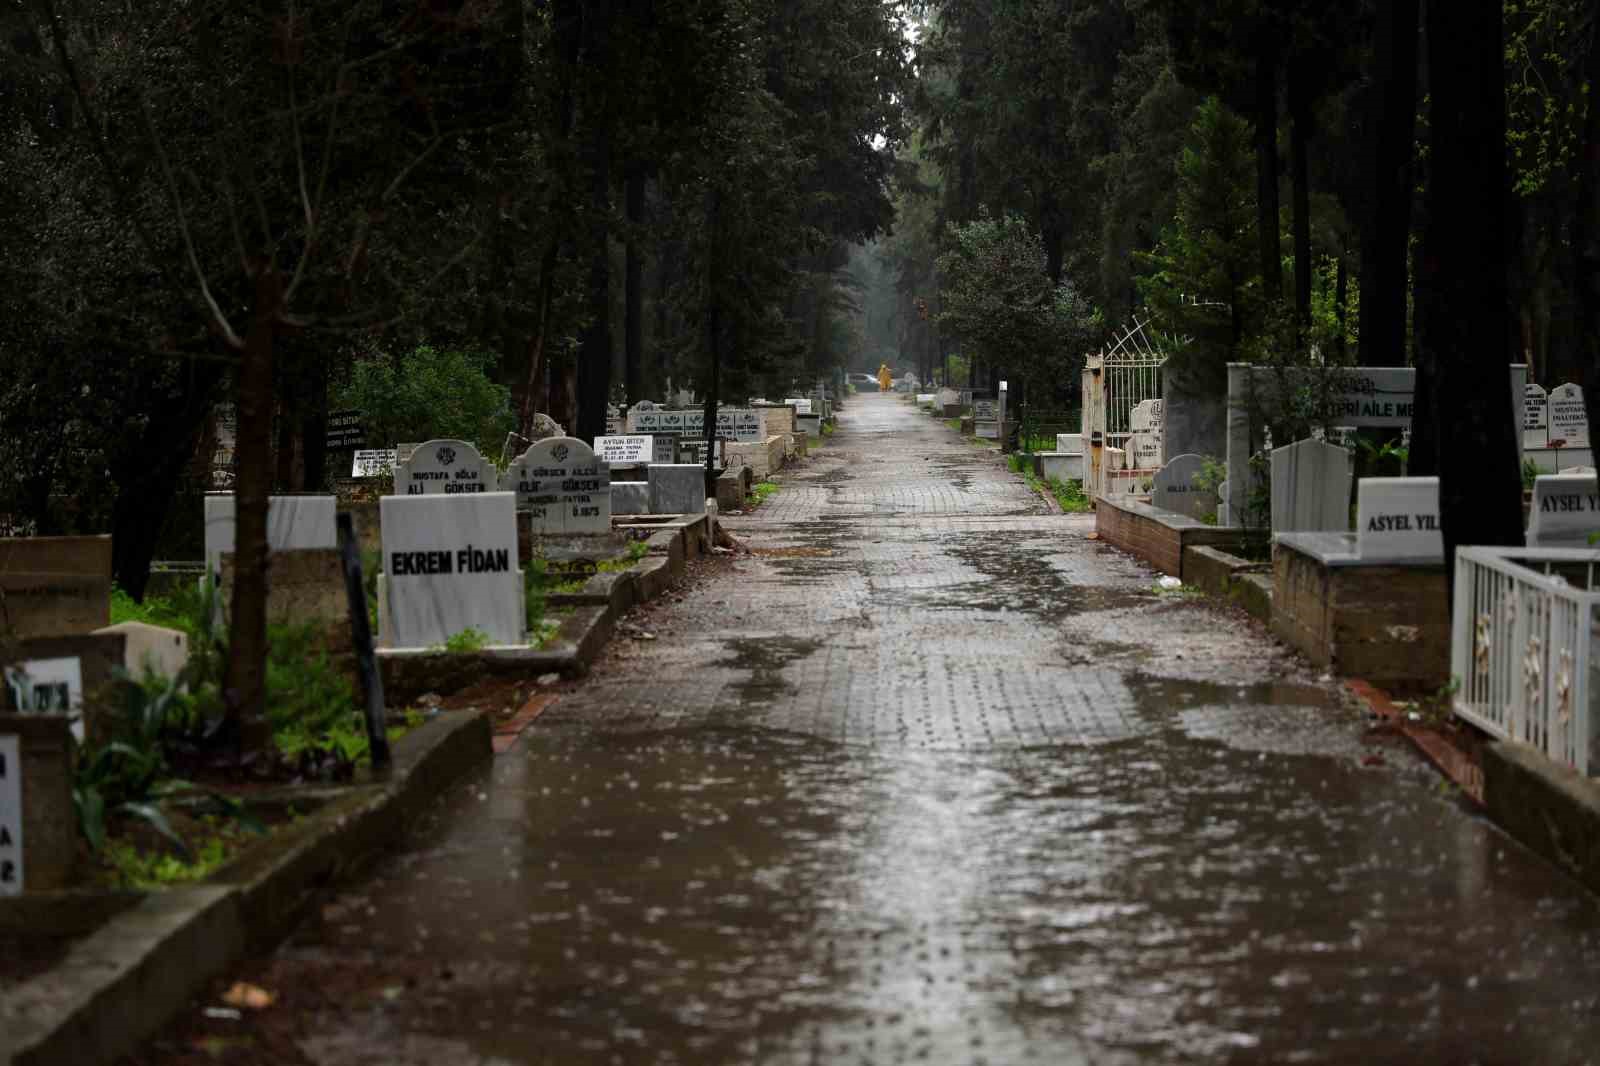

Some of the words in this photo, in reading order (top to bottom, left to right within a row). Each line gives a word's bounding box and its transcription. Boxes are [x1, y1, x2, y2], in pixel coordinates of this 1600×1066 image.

[1540, 495, 1585, 512] AYSEL
[1368, 514, 1412, 531] ASYEL
[391, 551, 452, 575] EKREM
[456, 544, 509, 573] FİDAN
